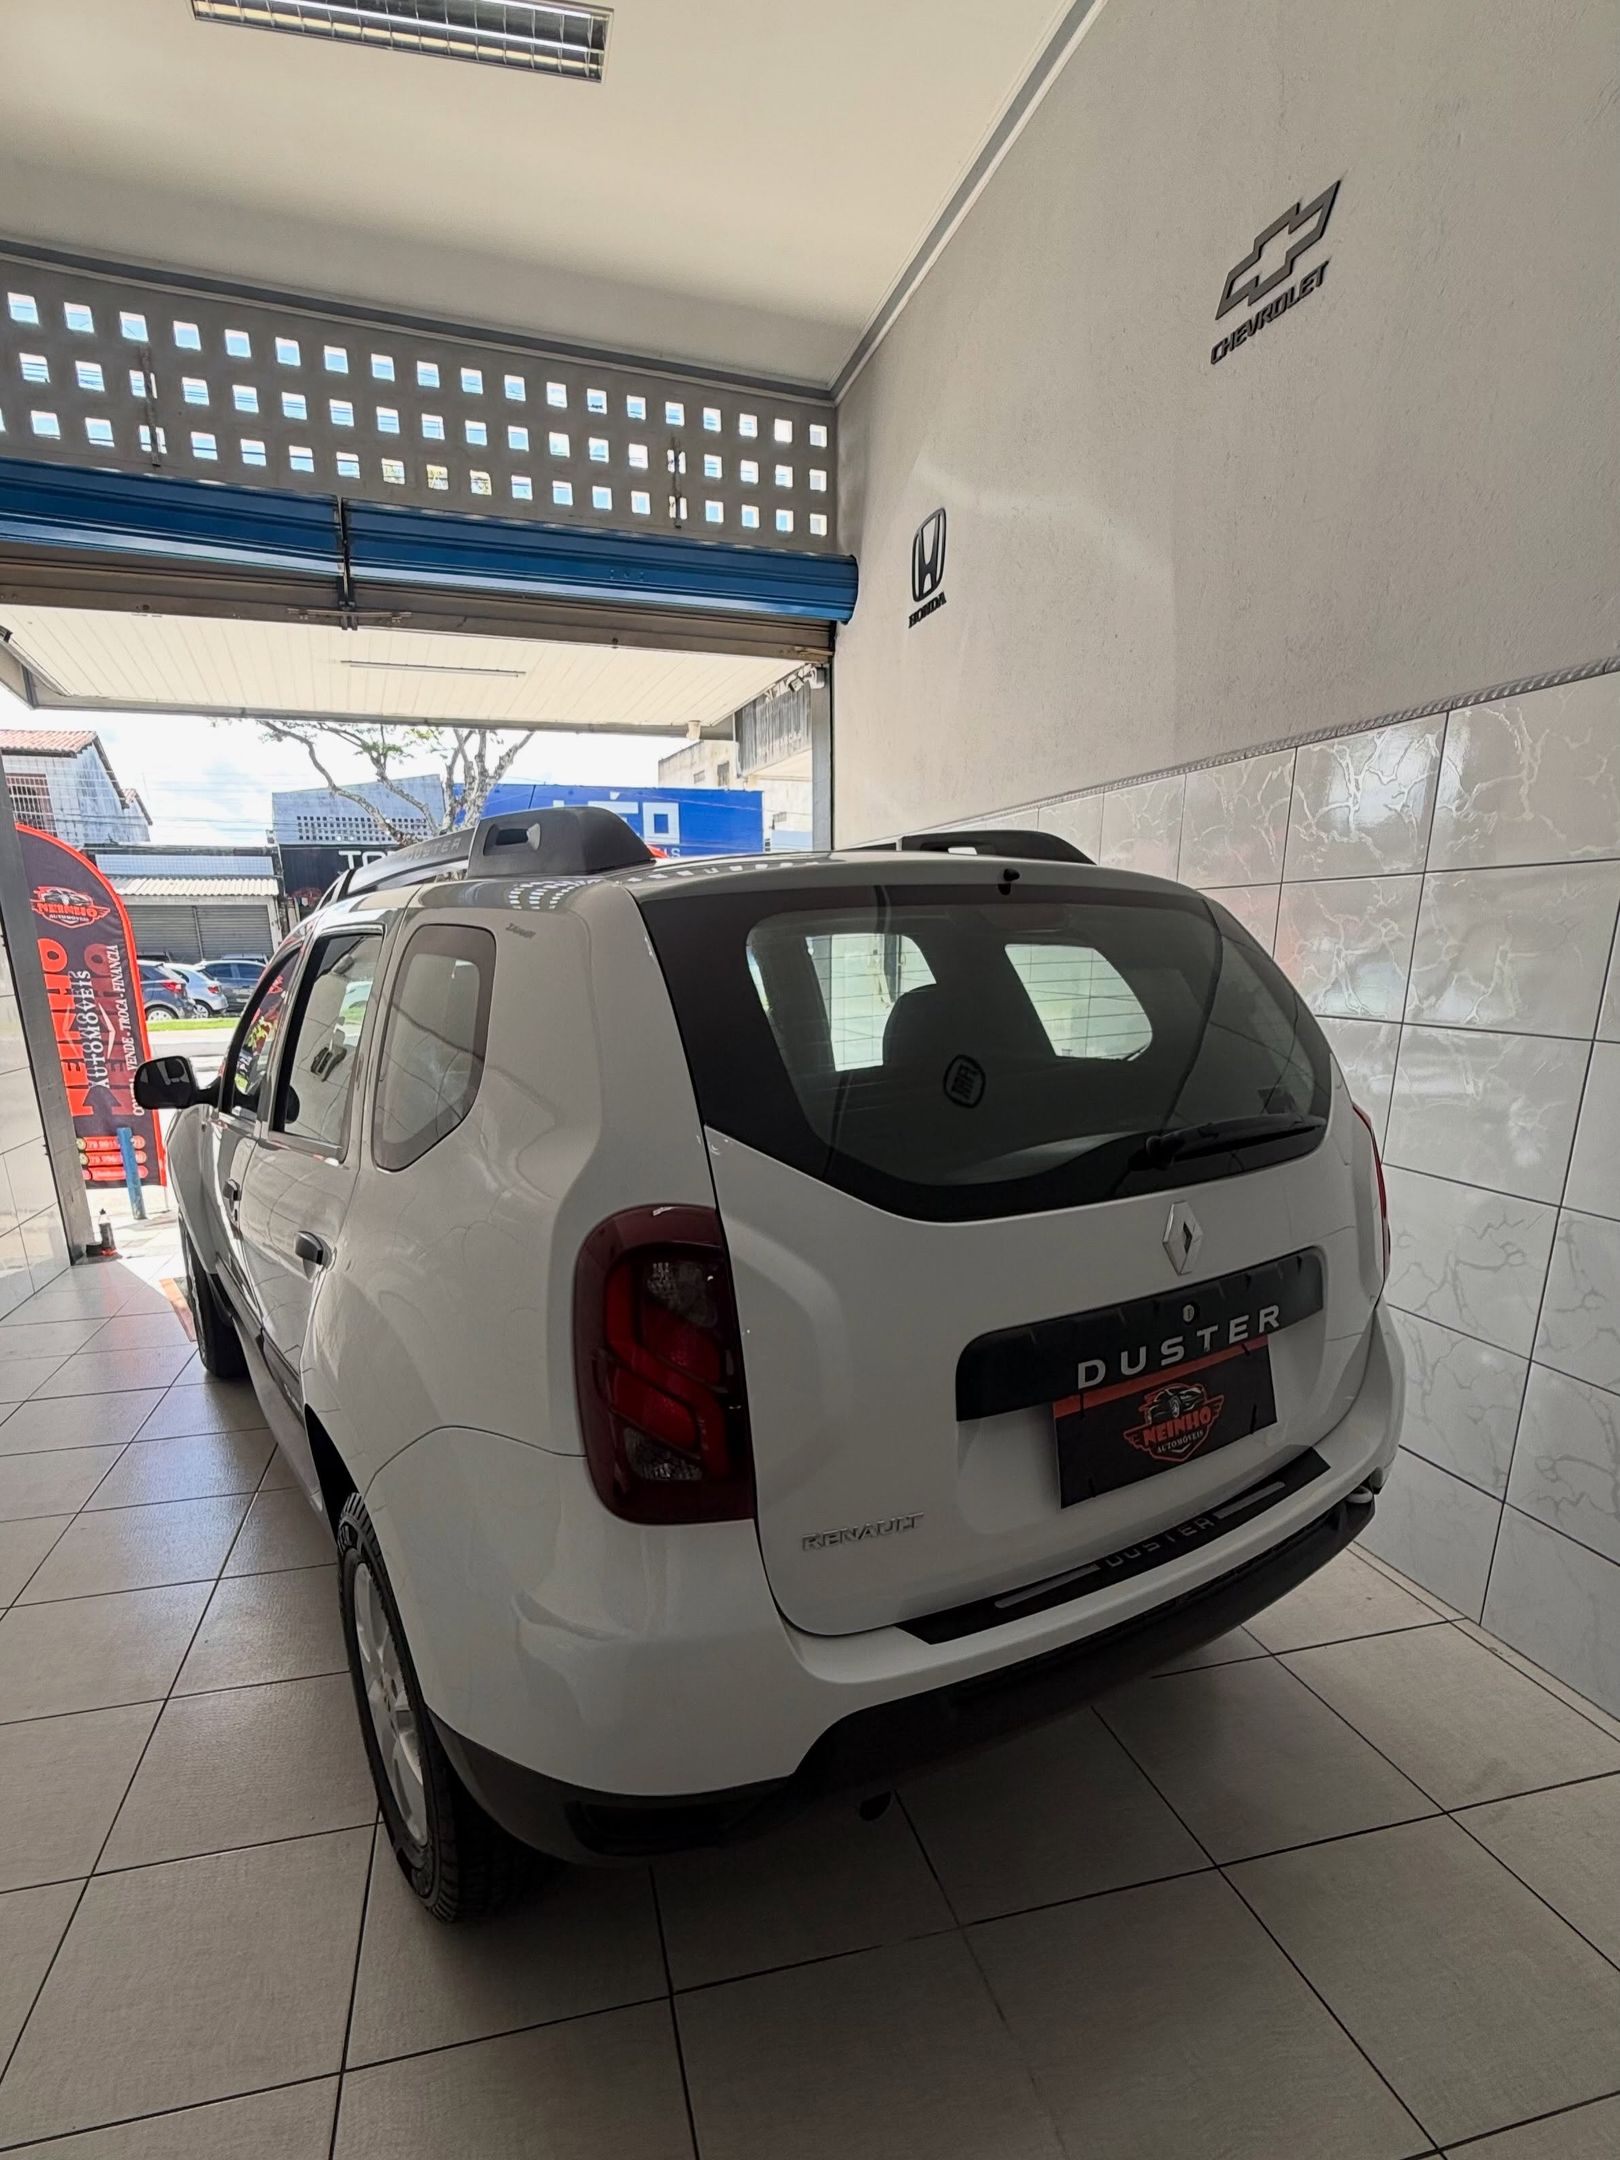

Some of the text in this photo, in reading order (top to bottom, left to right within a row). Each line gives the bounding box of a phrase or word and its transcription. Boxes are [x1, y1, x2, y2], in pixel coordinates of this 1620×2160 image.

[1210, 259, 1330, 366] CHEVROLET
[908, 591, 947, 629] HONDA
[106, 944, 126, 993] FINANCIA
[117, 998, 131, 1032] TROCA
[121, 1036, 138, 1072] VENDE
[1077, 1304, 1280, 1390] DUSTER
[1142, 1405, 1212, 1448] NEINHO
[802, 1511, 924, 1551] RENAULT
